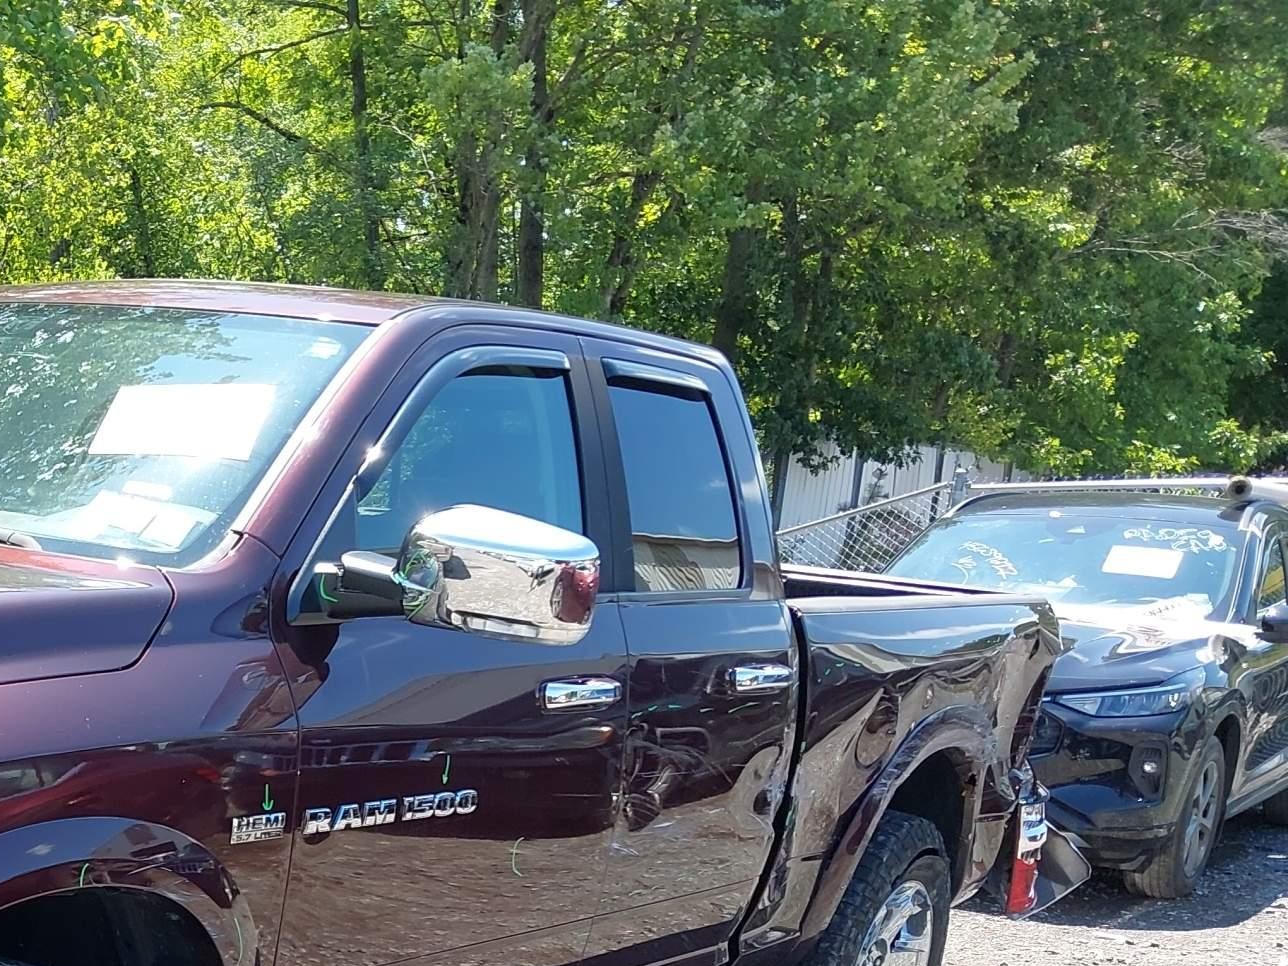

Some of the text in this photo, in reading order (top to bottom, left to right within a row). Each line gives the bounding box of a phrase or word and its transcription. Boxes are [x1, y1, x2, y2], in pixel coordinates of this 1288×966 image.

[236, 813, 286, 831] HEMI
[303, 789, 478, 835] RAM 1500
